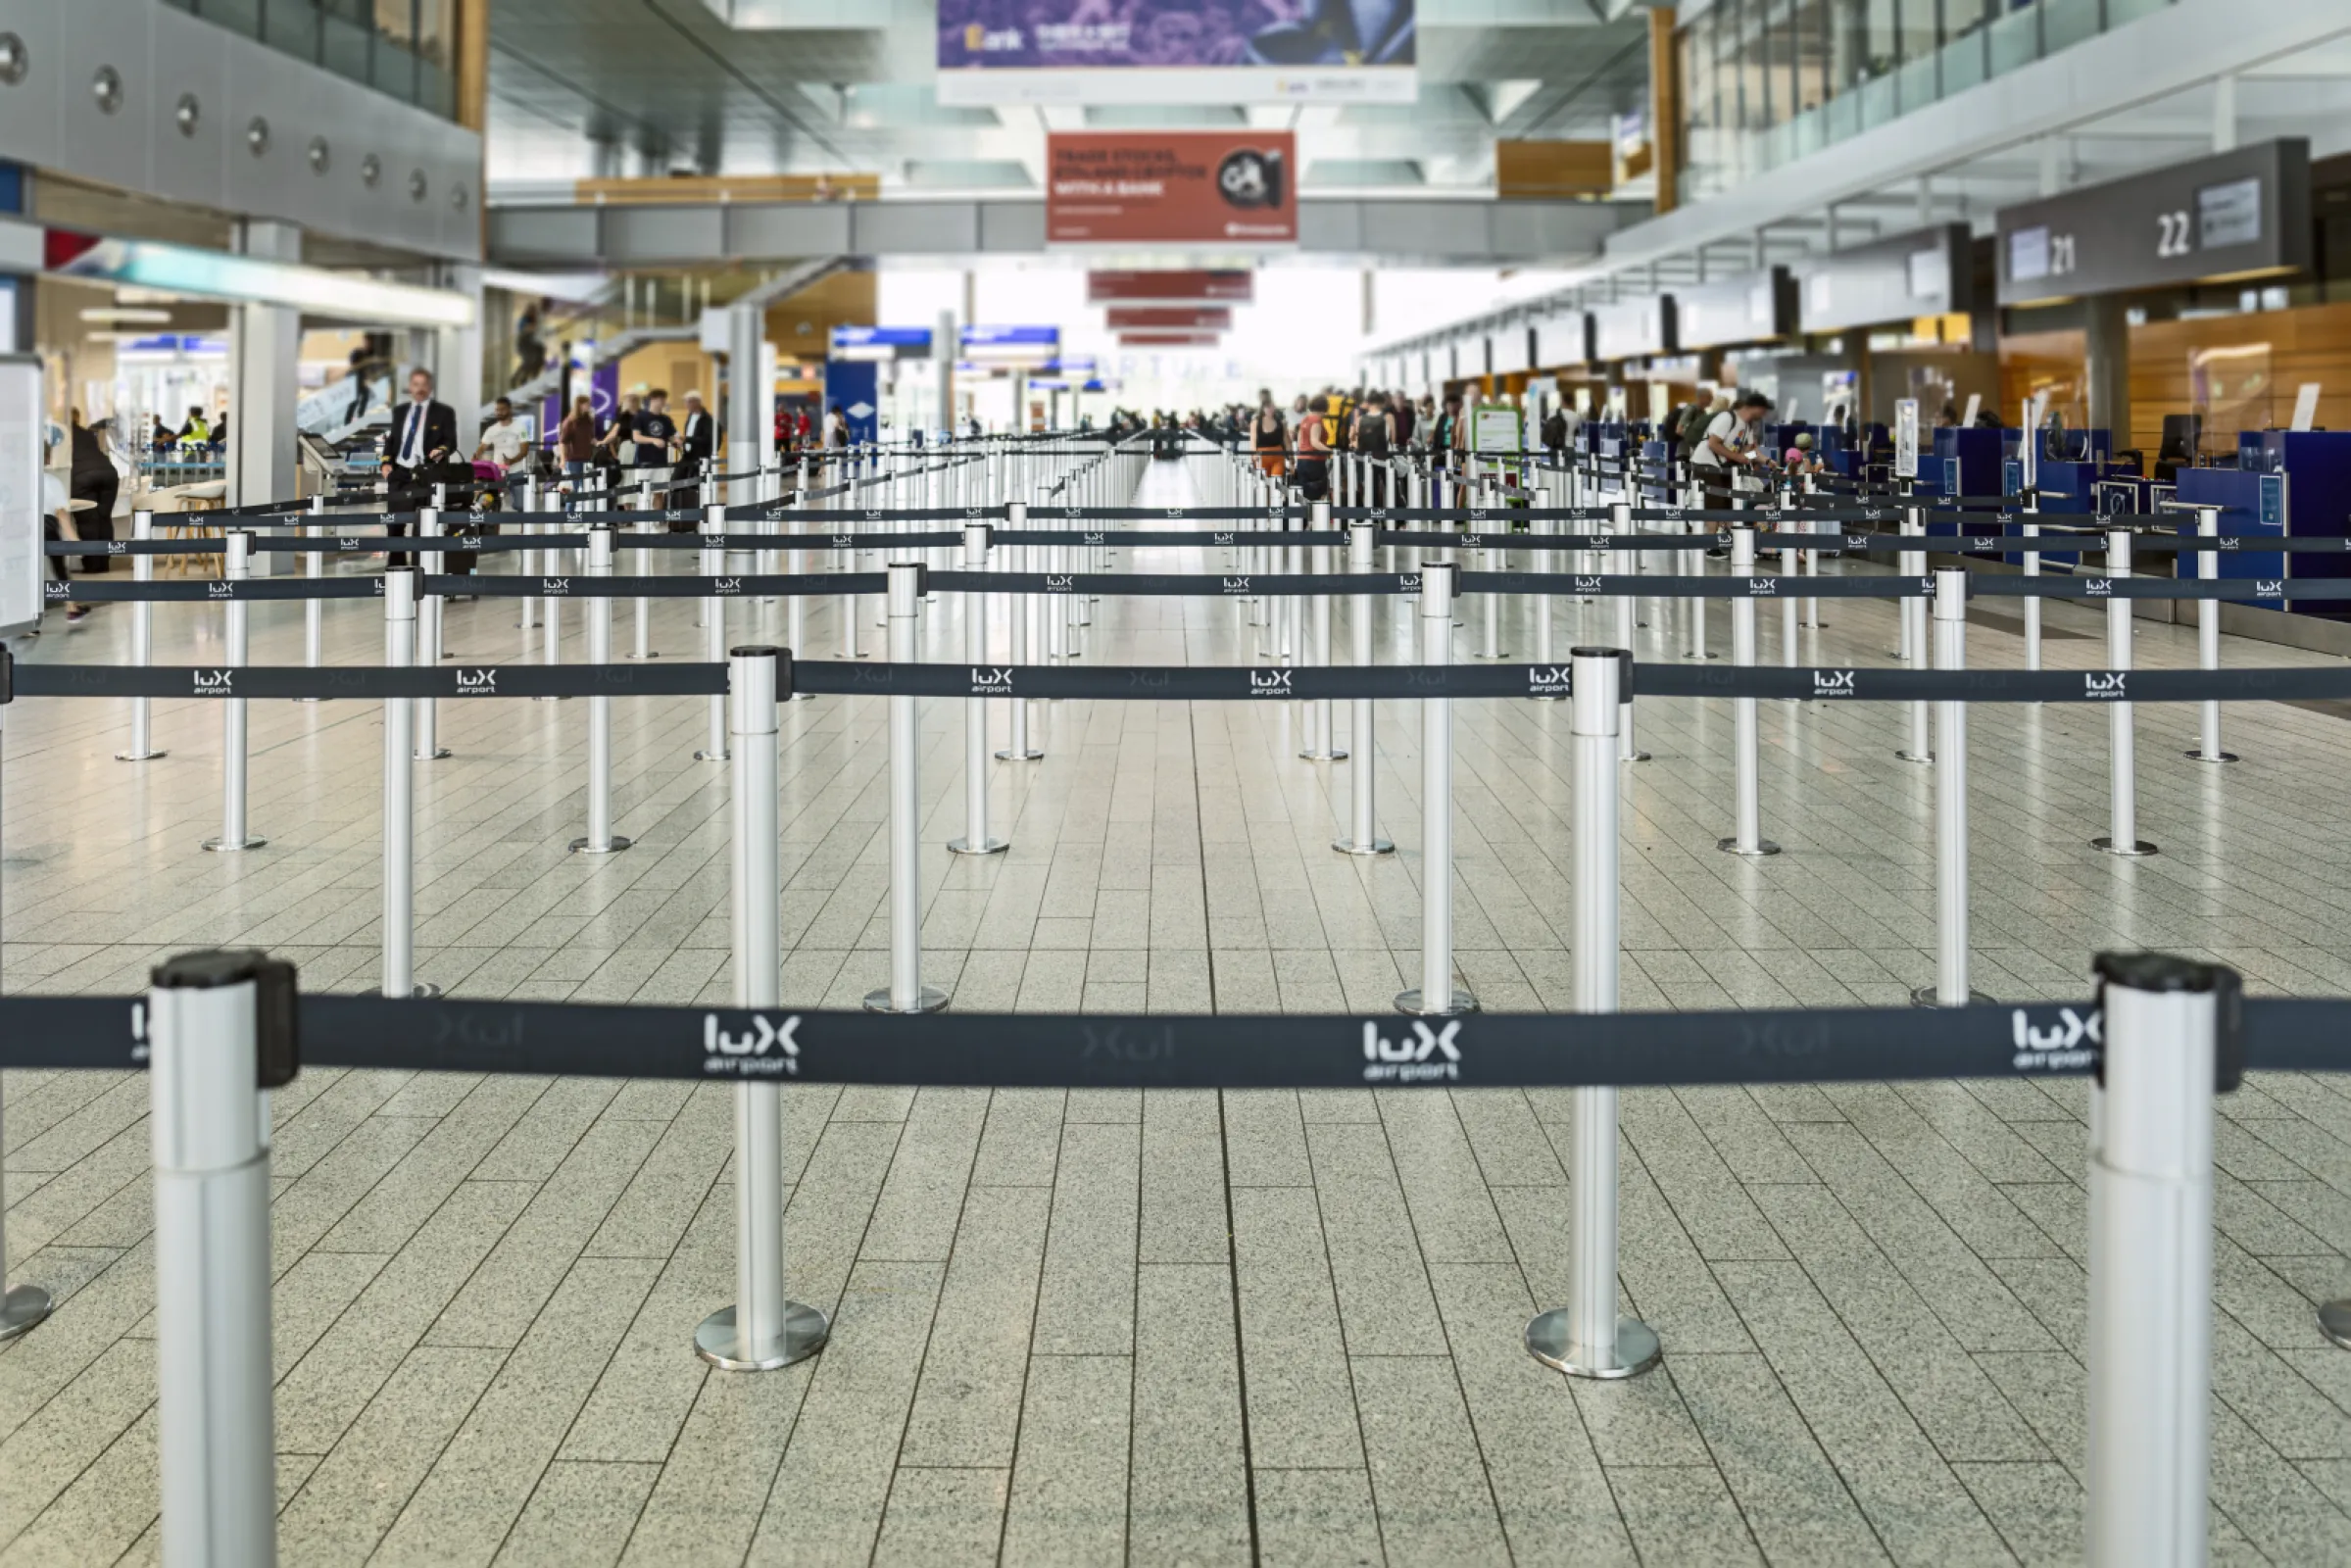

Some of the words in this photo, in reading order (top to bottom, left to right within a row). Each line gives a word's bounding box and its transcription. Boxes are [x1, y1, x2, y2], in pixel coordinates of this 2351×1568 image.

[2156, 211, 2190, 259] 22
[2050, 234, 2076, 275] 21
[47, 583, 70, 592] luX
[210, 583, 232, 592] luX
[374, 579, 385, 588] lu
[544, 579, 568, 588] luX
[715, 578, 740, 588] luX
[1048, 576, 1072, 585] luX
[1224, 577, 1249, 587] luX
[1576, 577, 1600, 586] luX
[1750, 579, 1775, 588] luX
[1922, 578, 1935, 588] lu
[2086, 579, 2111, 589] luX
[2257, 581, 2281, 591] luX
[194, 670, 231, 685] luX
[457, 670, 495, 685] luX
[972, 668, 1012, 683] luX
[1251, 670, 1292, 686] luX
[1530, 667, 1569, 683] luX
[1815, 671, 1854, 686] luX
[2086, 673, 2125, 689] luX
[1530, 684, 1568, 693] airport
[705, 1015, 800, 1054] luX
[2012, 1008, 2101, 1050] luX
[1364, 1021, 1460, 1061] luX
[705, 1057, 797, 1073] airport
[2013, 1052, 2098, 1069] airpor
[1364, 1063, 1457, 1080] airport
